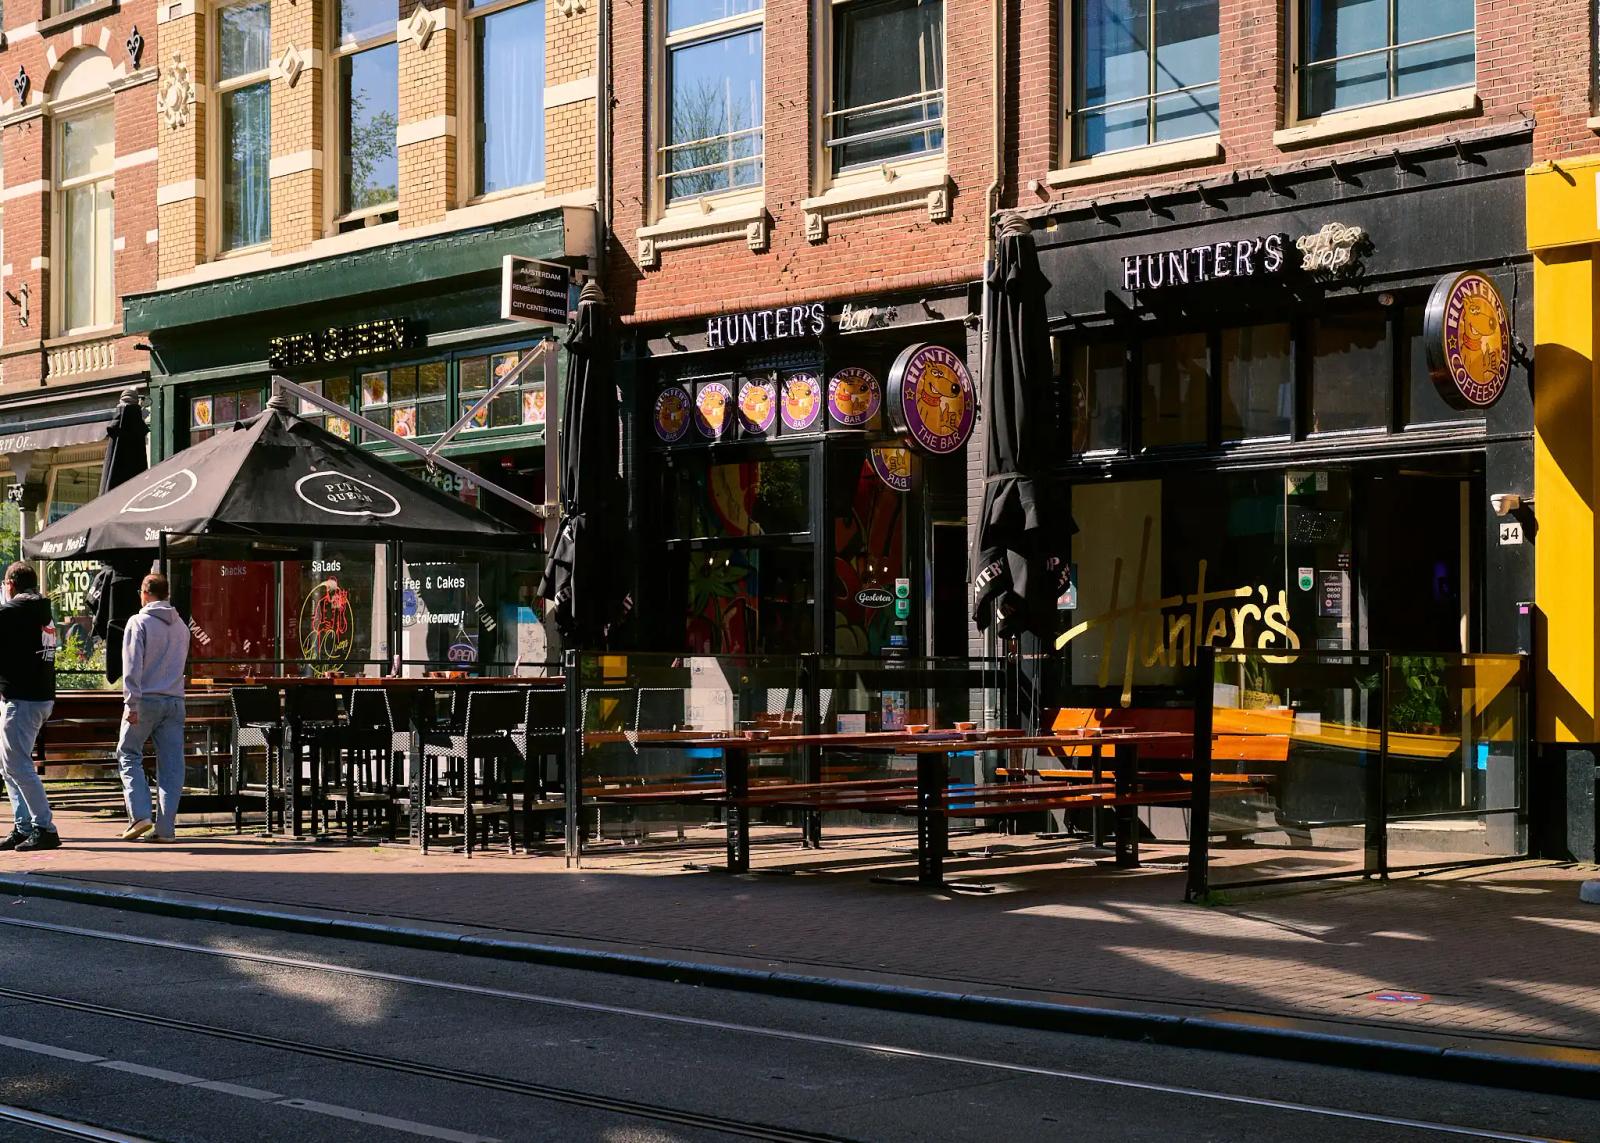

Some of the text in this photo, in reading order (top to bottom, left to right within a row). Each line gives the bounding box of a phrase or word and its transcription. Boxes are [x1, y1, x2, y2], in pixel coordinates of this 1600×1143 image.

[1123, 234, 1284, 290] HUNTER'S
[520, 267, 561, 281] AMSTERDAM
[512, 283, 567, 300] REMBRANDT SQUARE
[512, 301, 566, 316] CITY CENTER HOTEL
[1447, 280, 1506, 328] HUNTER'S
[838, 303, 877, 331] Bar
[707, 303, 826, 347] HUNTER'S
[907, 349, 971, 393] HUNTER'S
[1451, 349, 1509, 401] COFFEESHOP
[828, 368, 878, 393] HUNTER'S
[792, 420, 806, 428] BAR
[843, 414, 862, 424] BAR
[917, 424, 961, 450] THE BAR
[325, 482, 362, 493] PITA
[1503, 527, 1519, 541] 14
[40, 541, 63, 553] Warm
[60, 560, 102, 572] TRAVEL
[220, 565, 247, 577] Snacks
[312, 560, 341, 573] Salads
[74, 572, 90, 591] TO
[425, 577, 432, 589] &
[436, 575, 465, 589] Cakes
[60, 592, 86, 612] LIVE
[858, 593, 891, 604] Gesloten
[416, 611, 465, 626] takeaway!
[1056, 516, 1301, 707] Hunter's
[447, 648, 478, 662] OPEN
